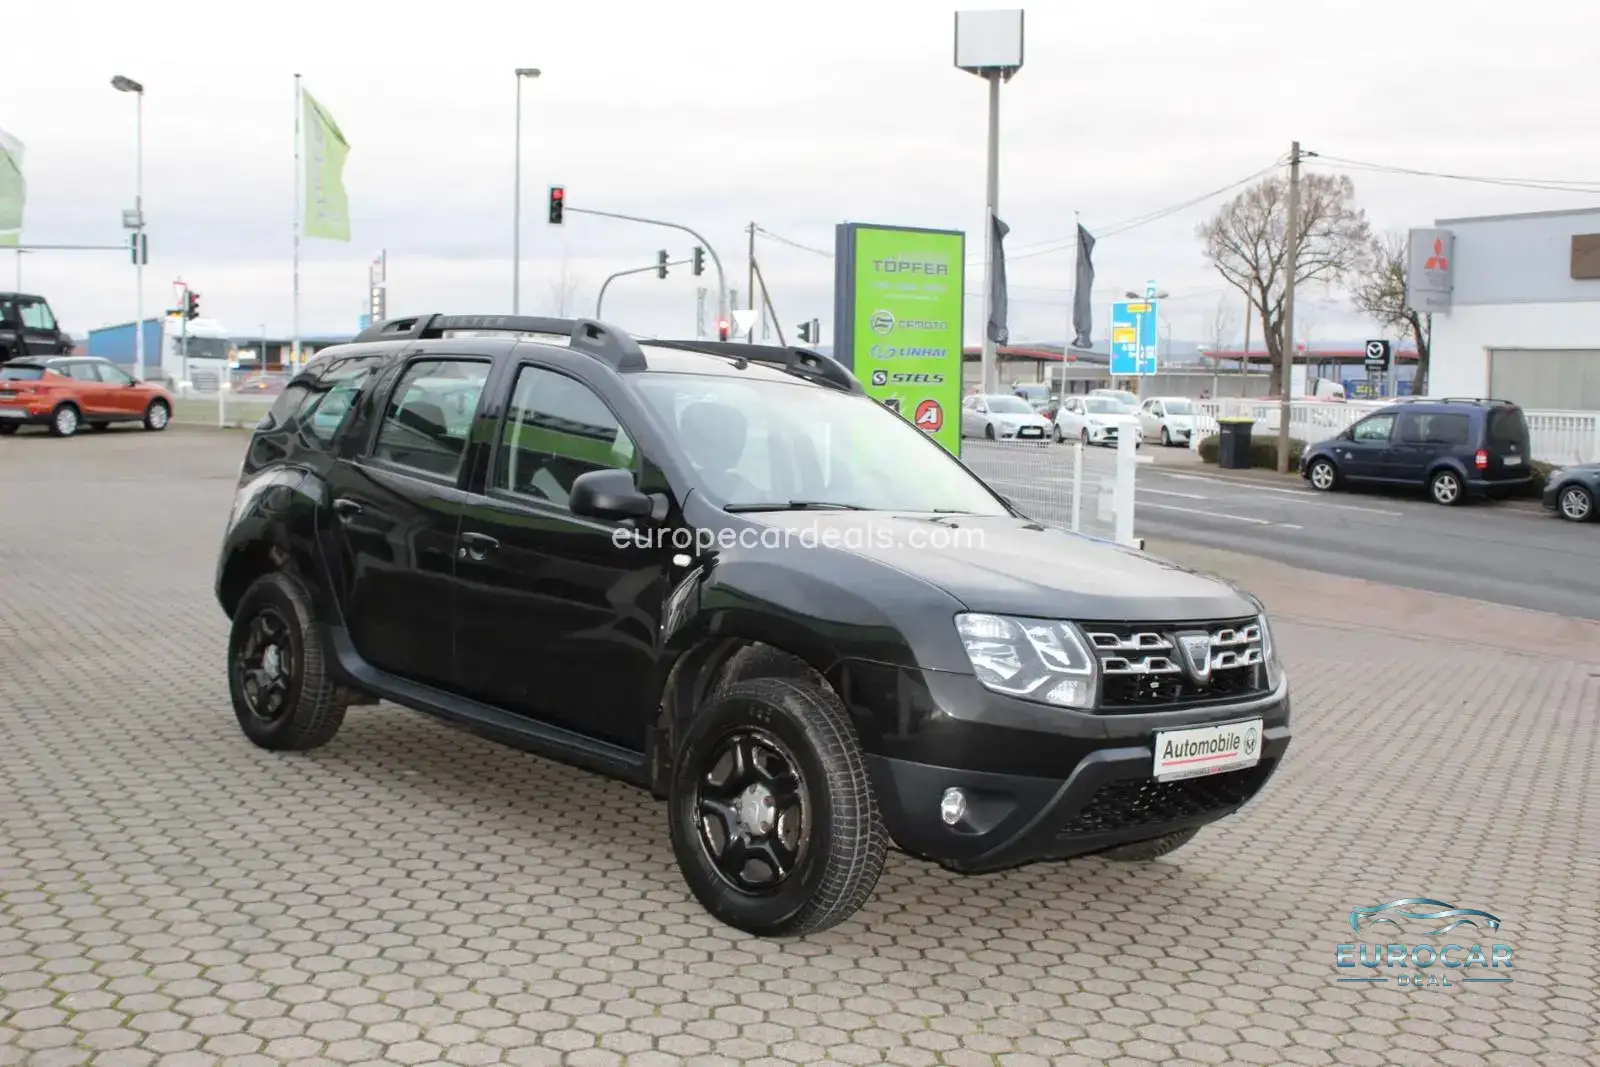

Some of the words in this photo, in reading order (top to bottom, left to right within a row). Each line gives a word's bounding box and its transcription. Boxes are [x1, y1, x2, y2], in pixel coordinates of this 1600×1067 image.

[872, 256, 948, 275] TÖPFER
[900, 347, 946, 357] LINHAI
[892, 373, 944, 383] STELS
[1162, 733, 1240, 760] Automobile
